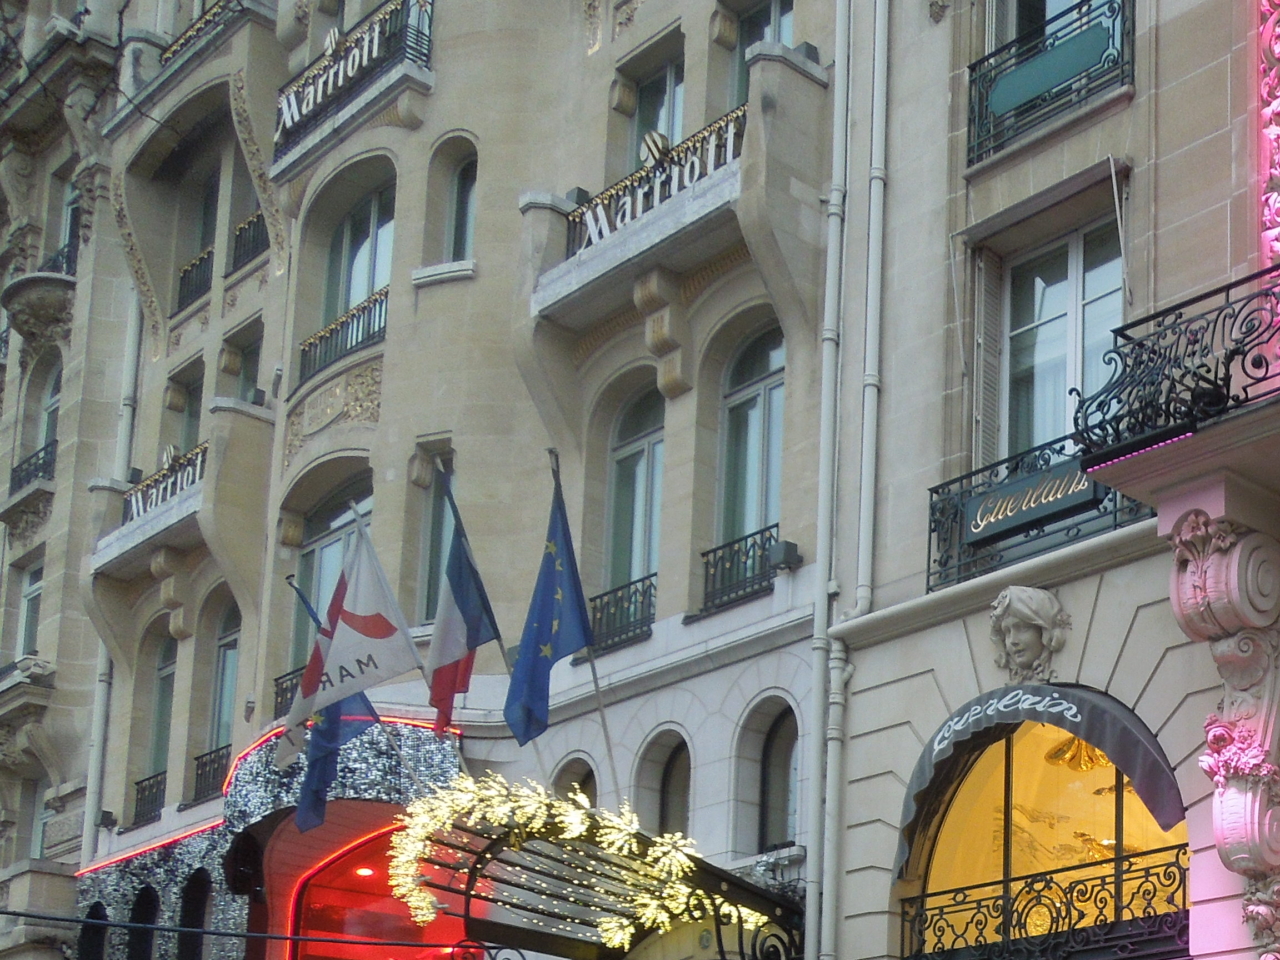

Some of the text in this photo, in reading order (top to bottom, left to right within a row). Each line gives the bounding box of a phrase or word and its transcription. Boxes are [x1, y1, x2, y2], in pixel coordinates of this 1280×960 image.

[273, 21, 380, 142] Marriott
[577, 120, 735, 253] Marriott
[126, 452, 203, 523] Marriot
[971, 470, 1089, 533] Guerlain
[932, 689, 1082, 762] Guerlain
